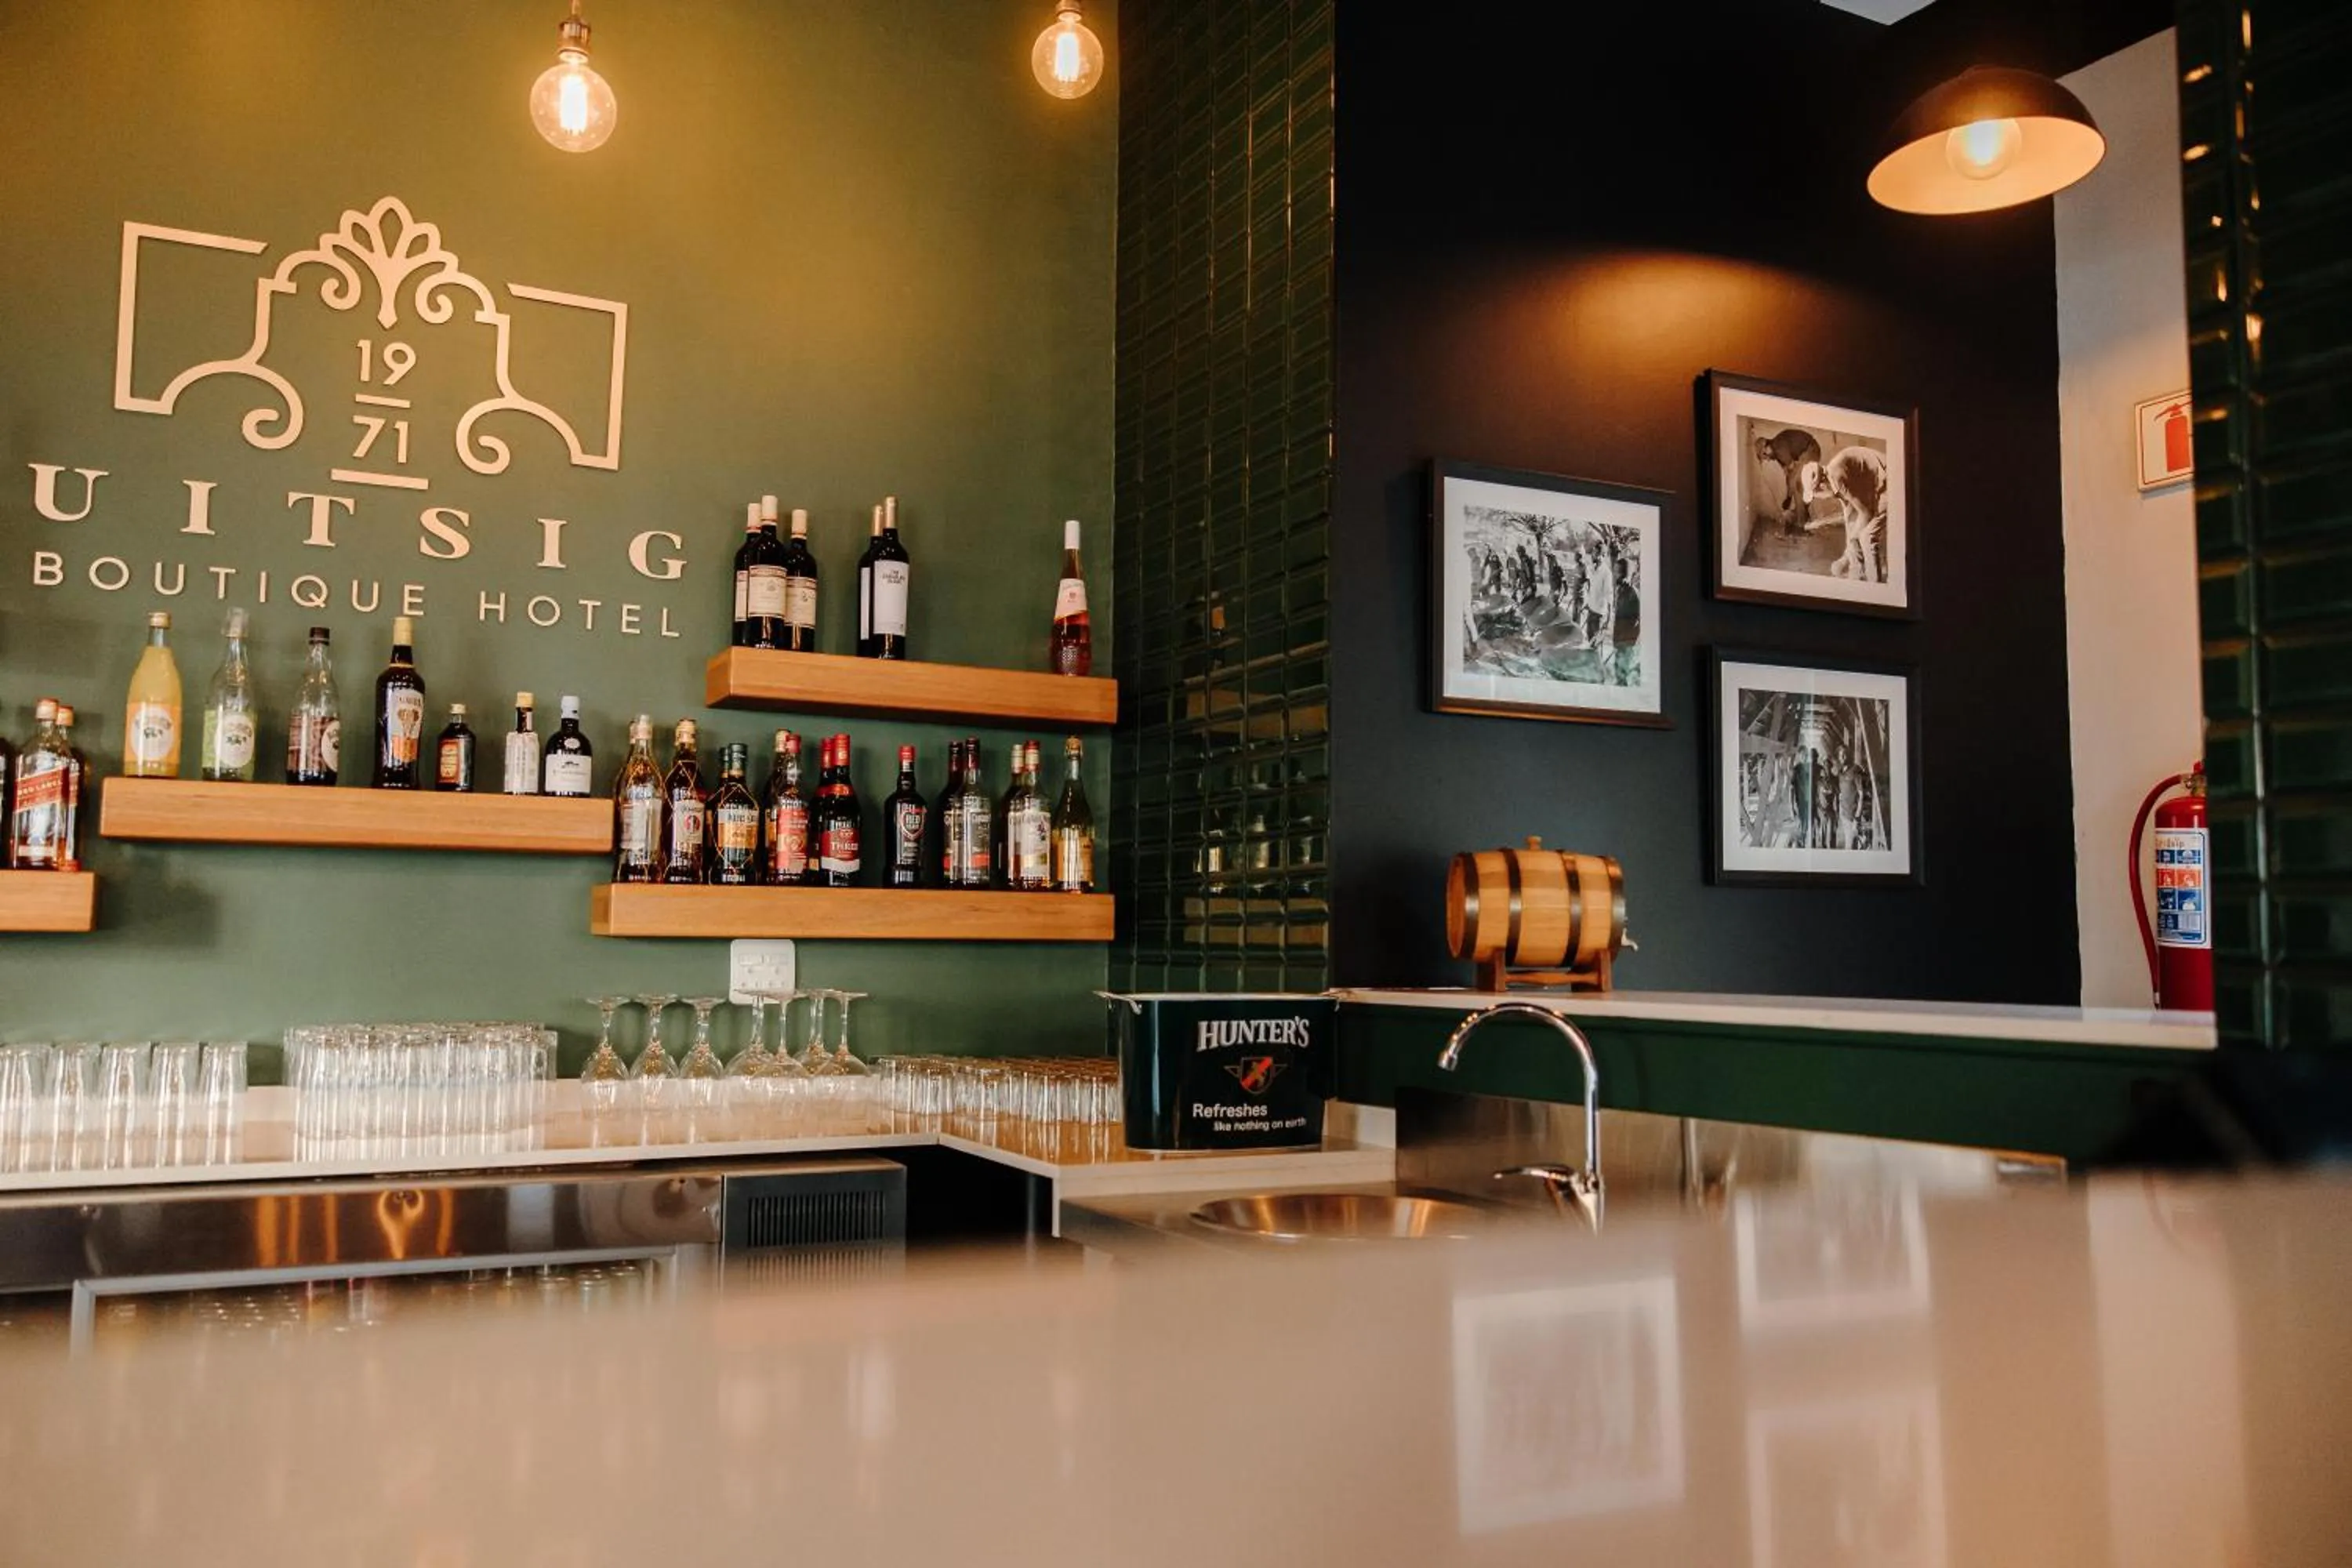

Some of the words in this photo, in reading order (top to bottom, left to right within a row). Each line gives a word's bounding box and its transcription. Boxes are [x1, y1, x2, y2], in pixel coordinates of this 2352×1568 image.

[357, 339, 416, 385] 19
[352, 415, 409, 463] 71
[28, 463, 688, 580] UITSIG
[33, 550, 426, 616] BOUTIQUE
[478, 591, 680, 637] HOTEL
[1196, 1015, 1310, 1052] HUNTER'S
[1192, 1103, 1268, 1118] Refreshes
[1214, 1120, 1231, 1131] like
[1234, 1120, 1269, 1131] nothing
[1272, 1120, 1283, 1129] on
[1285, 1117, 1307, 1127] earth
